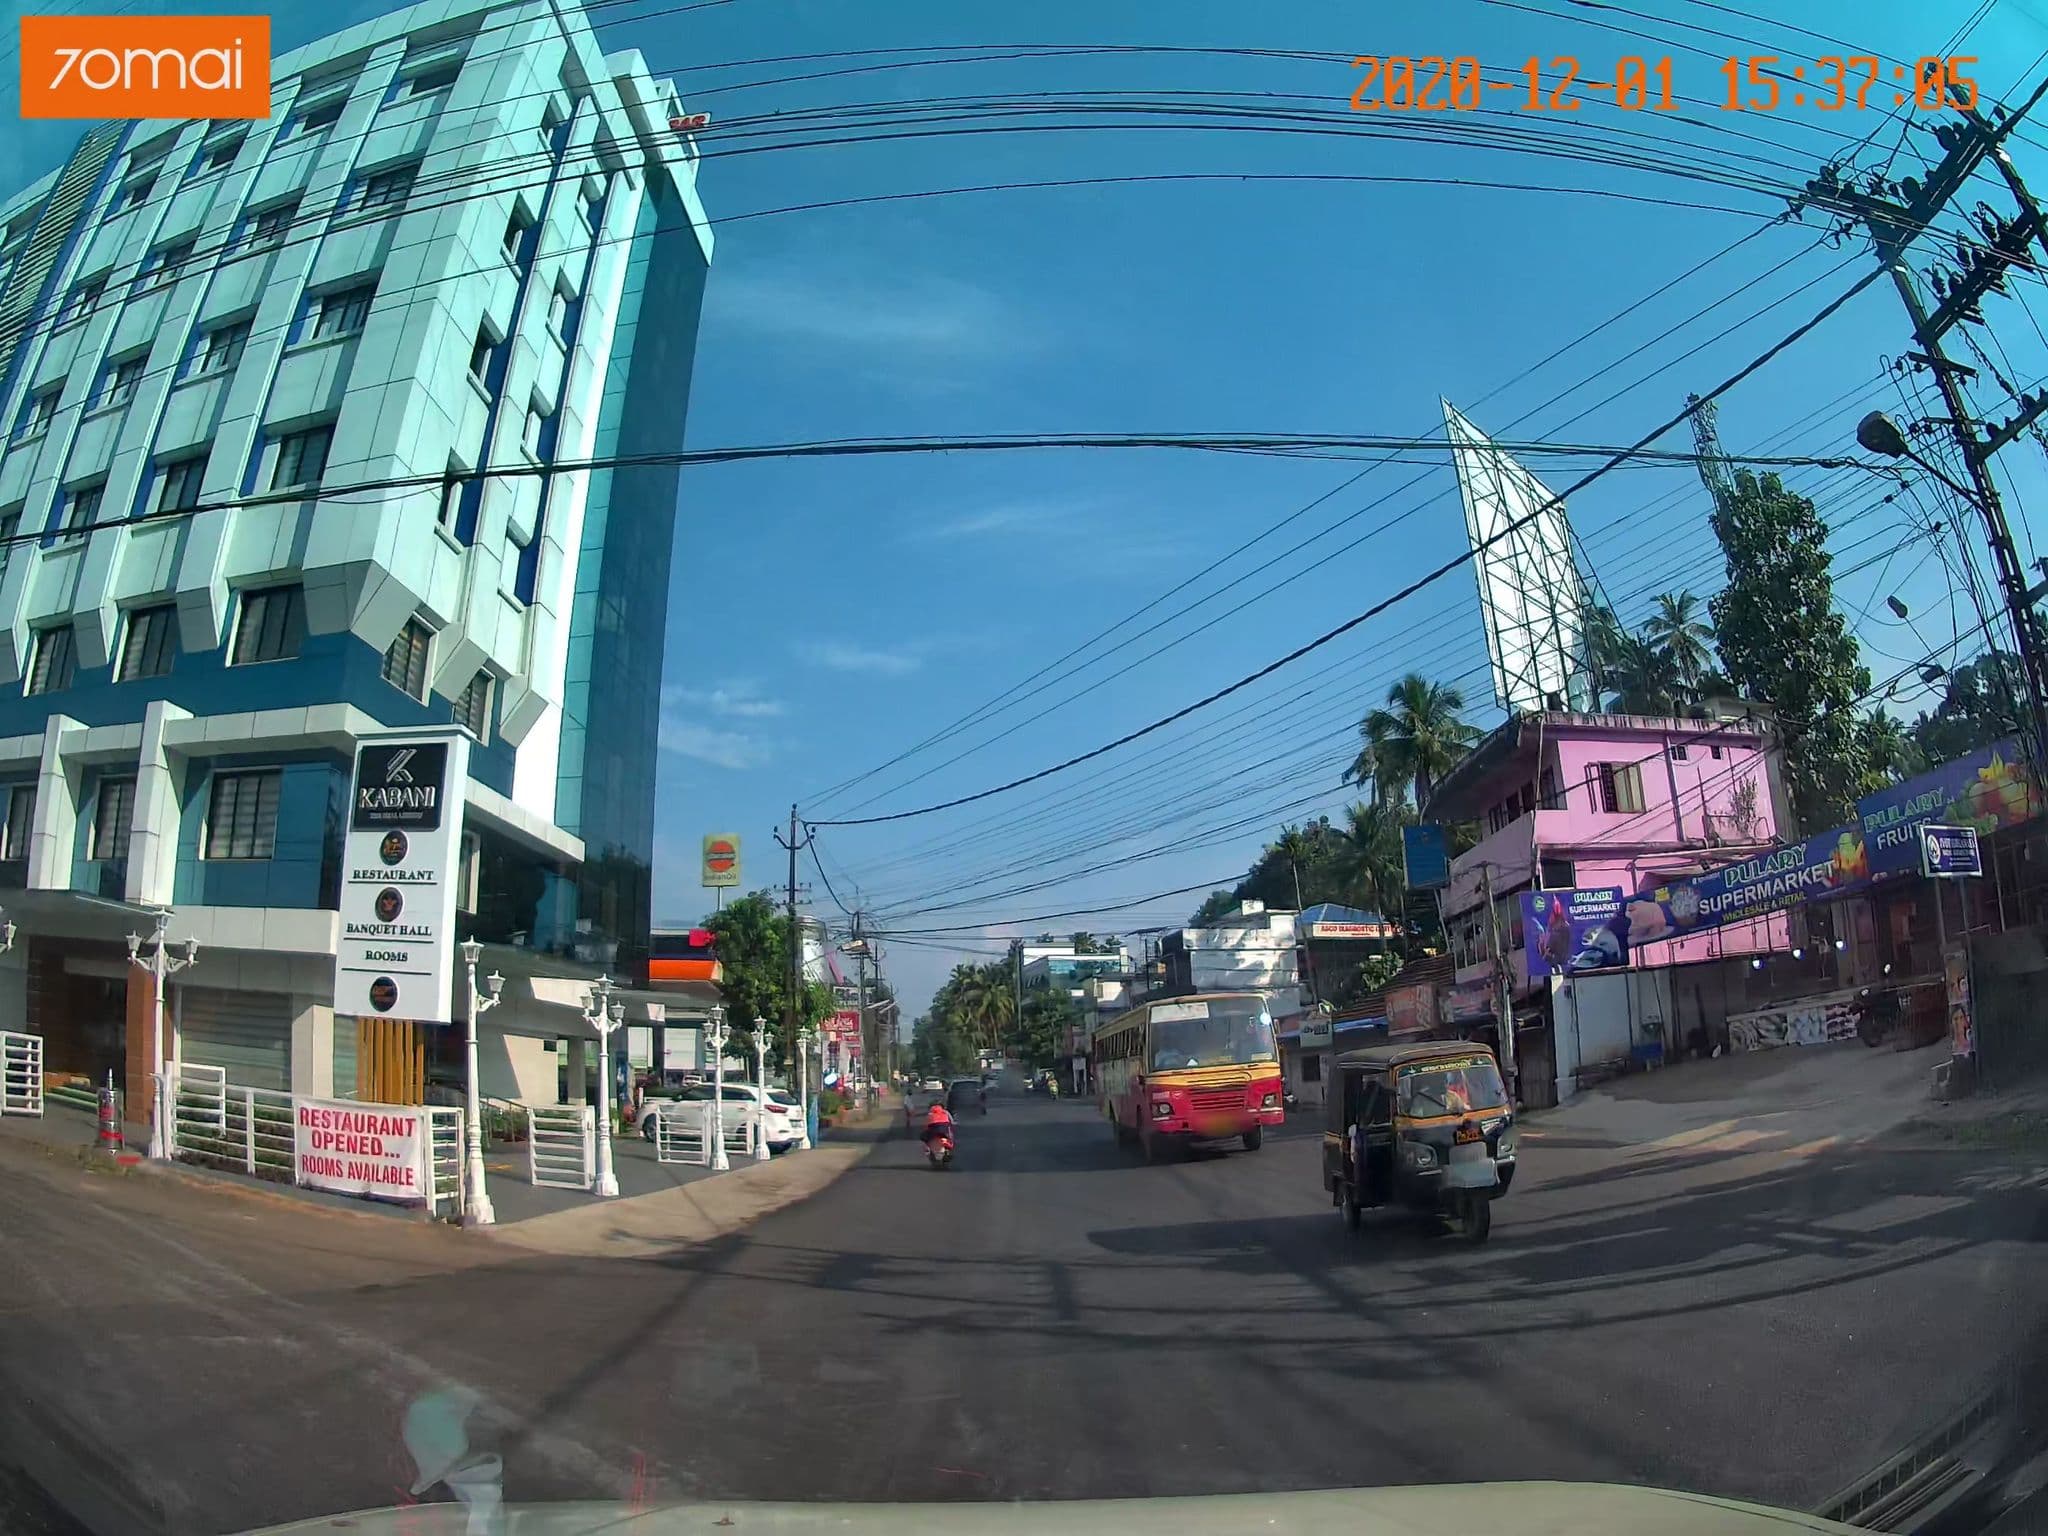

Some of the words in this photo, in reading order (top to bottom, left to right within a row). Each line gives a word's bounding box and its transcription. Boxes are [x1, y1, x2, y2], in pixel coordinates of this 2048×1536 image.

[359, 786, 436, 808] KABANI
[1863, 787, 1944, 833] PULARY
[352, 869, 434, 881] RESTAURANT
[1724, 843, 1807, 888] PULARY
[1699, 860, 1836, 915] SUPERMARKET
[1569, 903, 1620, 914] SUPERMARKET
[346, 922, 398, 936] BANQUET
[400, 922, 432, 936] HALL
[365, 950, 408, 962] ROOMS
[300, 1106, 416, 1137] RESTAURANT
[302, 1154, 343, 1178] ROOMS
[347, 1161, 414, 1186] AVAILABLE
